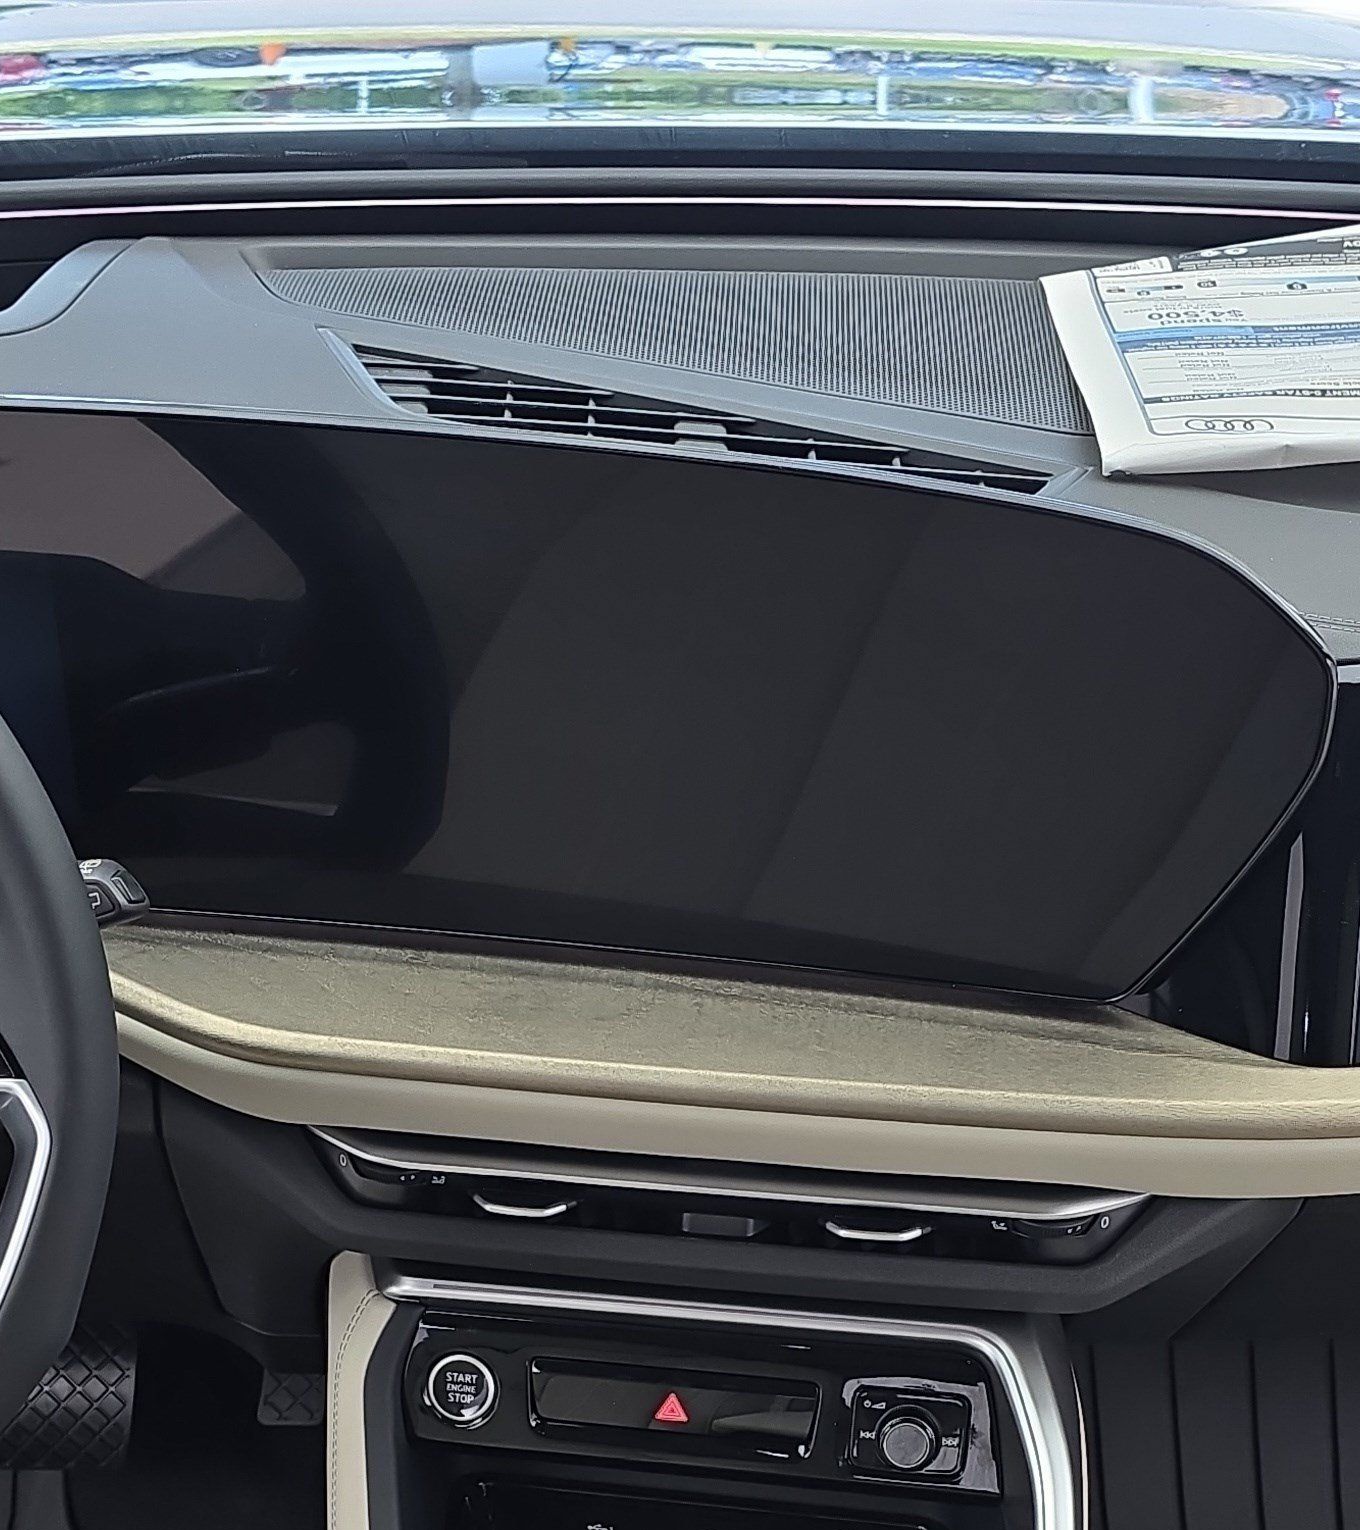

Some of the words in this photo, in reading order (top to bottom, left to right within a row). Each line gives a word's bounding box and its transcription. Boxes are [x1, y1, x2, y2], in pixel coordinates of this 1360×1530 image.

[1148, 310, 1244, 321] $4,500
[1159, 318, 1222, 326] spend
[1161, 393, 1220, 402] RATINGS
[445, 1371, 478, 1383] START
[446, 1383, 477, 1394] ENGINE
[447, 1392, 475, 1405] STOP
